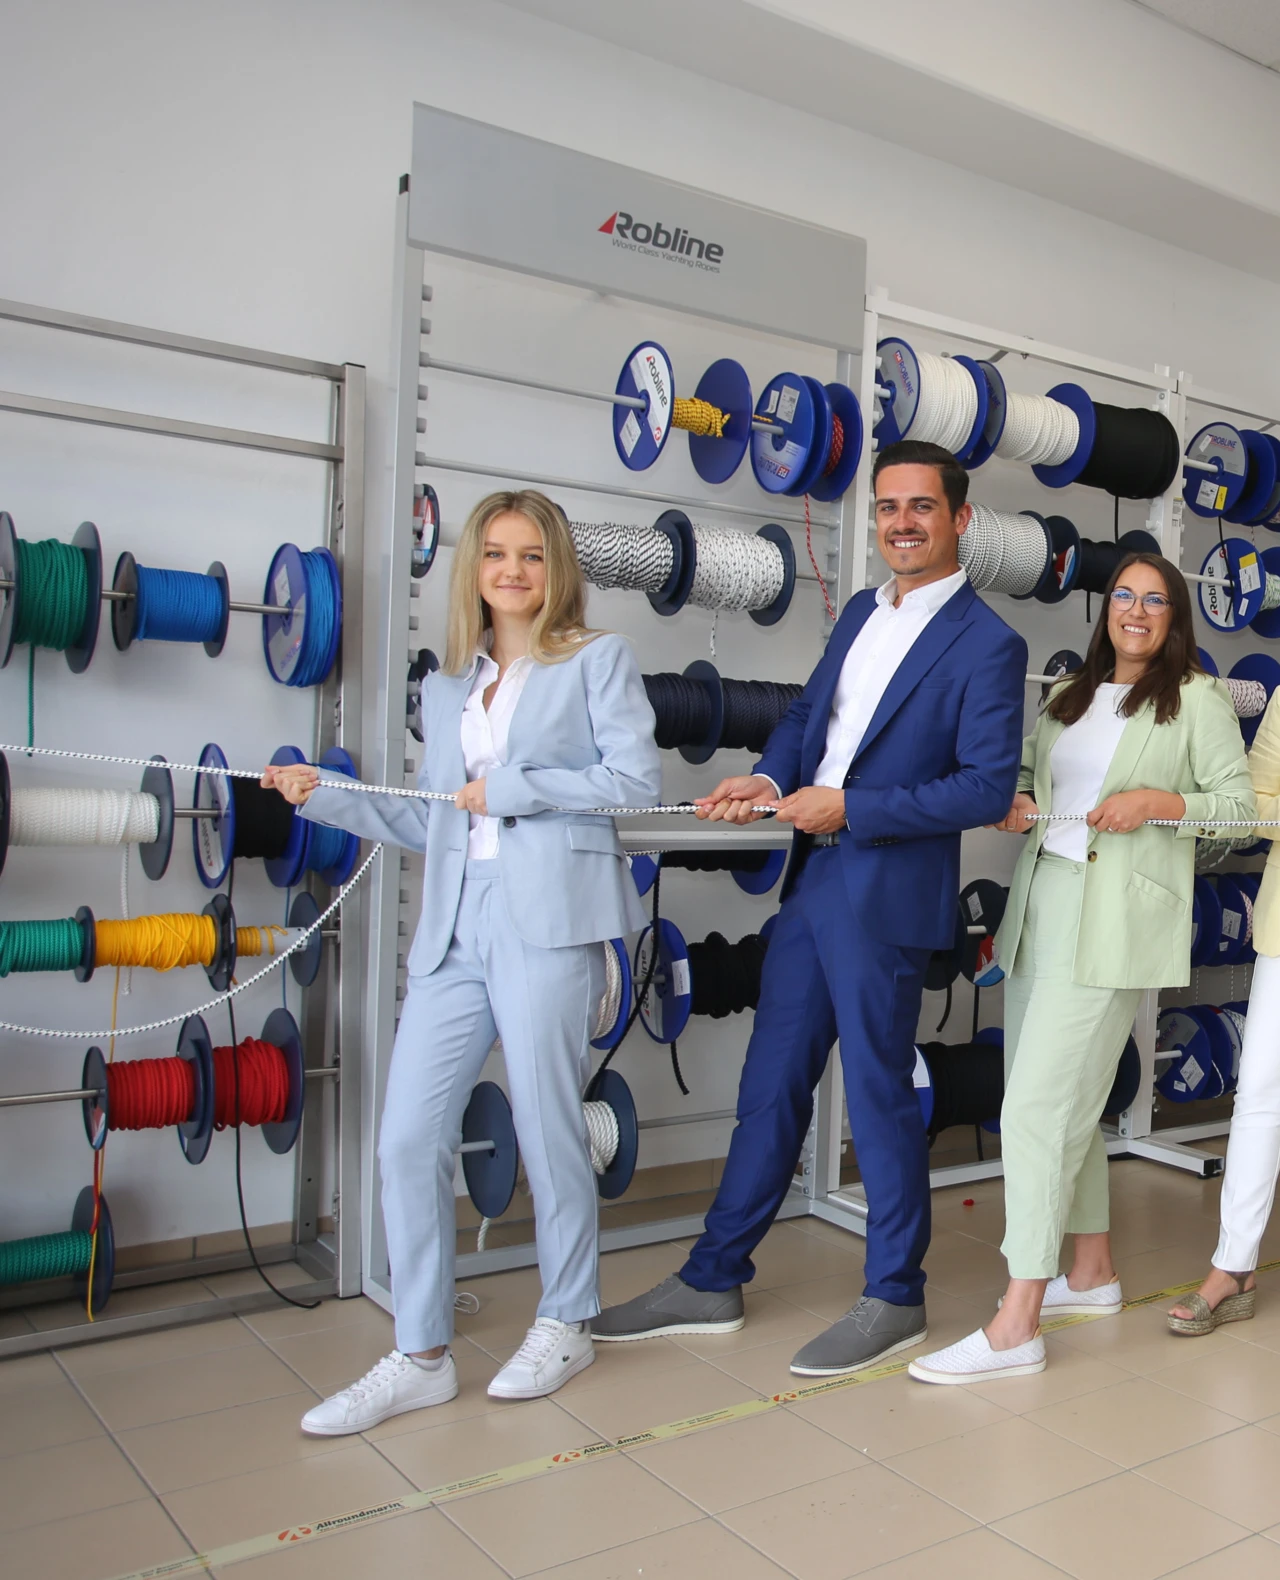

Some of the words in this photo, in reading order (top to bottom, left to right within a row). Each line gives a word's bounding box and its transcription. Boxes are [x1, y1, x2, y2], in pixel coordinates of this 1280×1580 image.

[612, 238, 637, 252] World
[637, 245, 660, 258] Class
[661, 251, 694, 268] Yachting
[695, 260, 720, 273] Ropes
[616, 211, 724, 264] Robline
[648, 356, 668, 408] Robline
[315, 1501, 401, 1530] Allroundmarin
